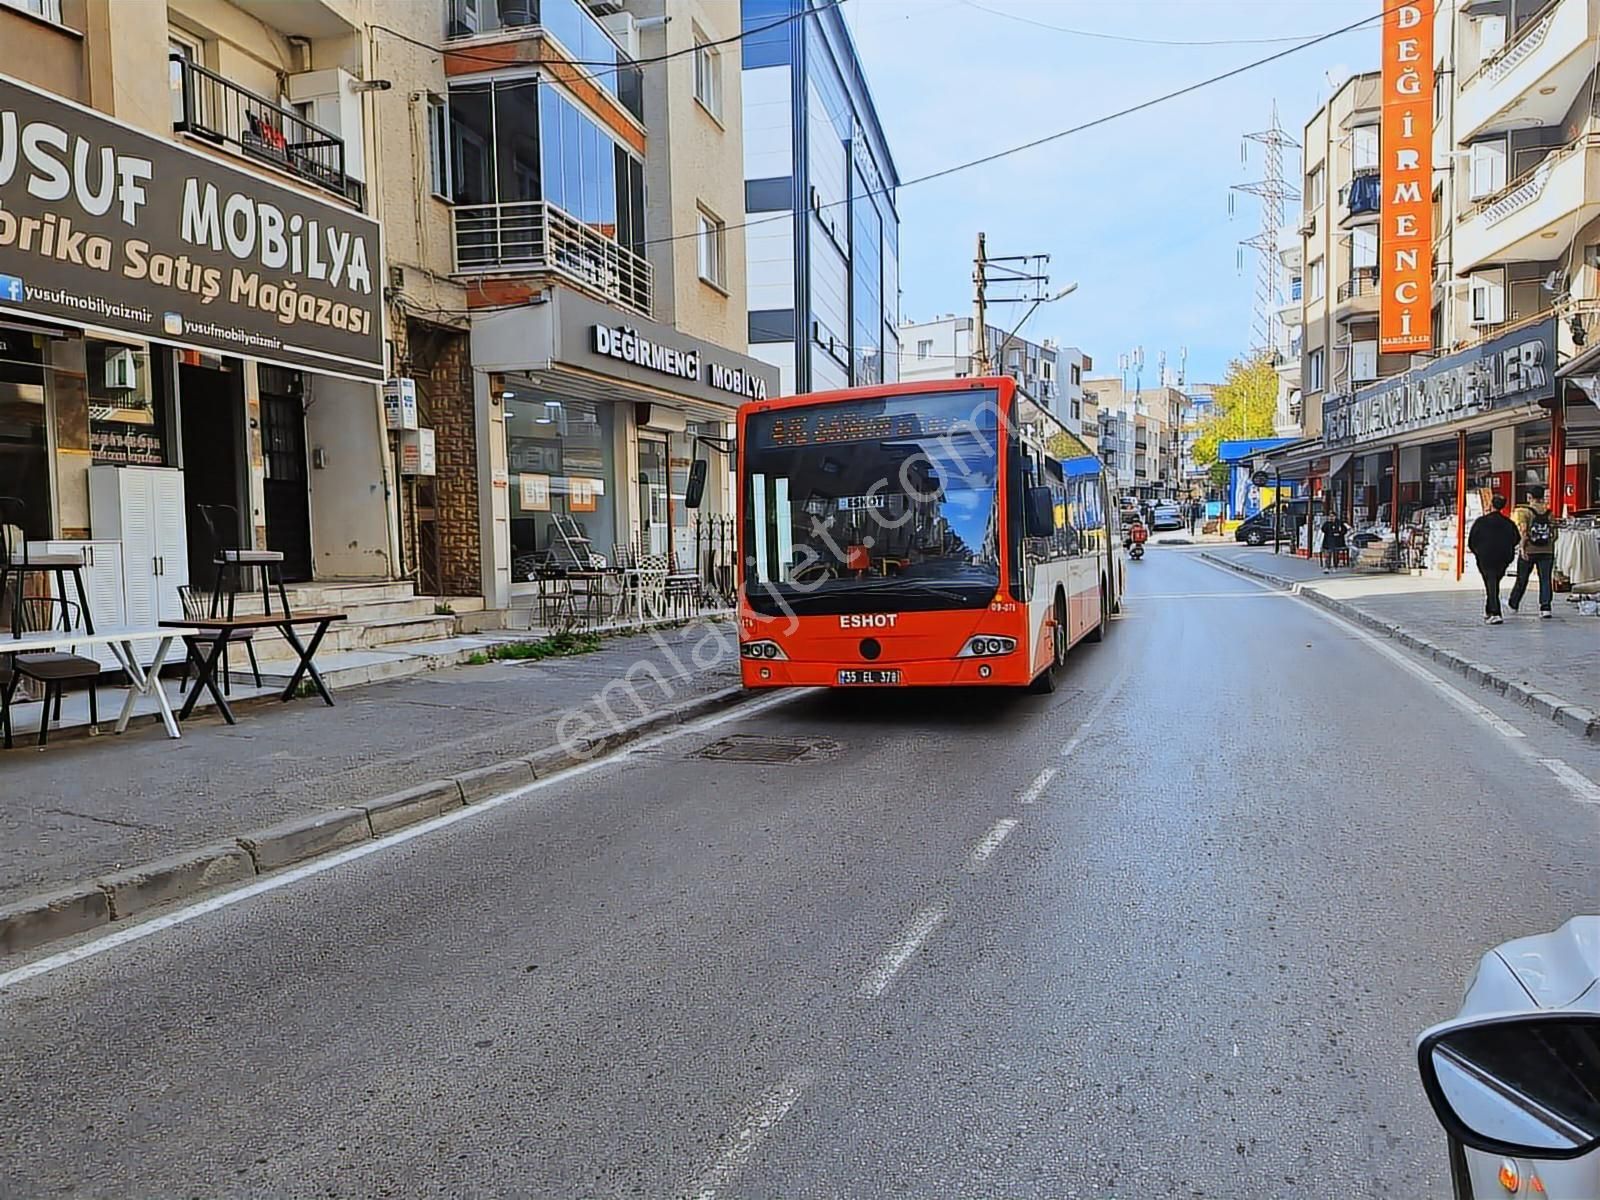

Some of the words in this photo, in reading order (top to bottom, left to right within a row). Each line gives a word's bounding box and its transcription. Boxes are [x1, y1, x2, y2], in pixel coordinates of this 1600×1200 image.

[1392, 6, 1423, 336] DEĞİRMENCİ
[25, 285, 153, 322] yusufmobilyaizmir
[123, 239, 222, 304] Satış
[230, 268, 371, 335] Mağazası
[184, 320, 281, 350] yusufmobilyaizmir
[594, 322, 700, 382] DEĞİRMENCİ
[711, 361, 767, 400] MOBİLYA
[840, 613, 898, 628] ESHOT
[846, 671, 857, 683] 35
[863, 671, 875, 683] EL
